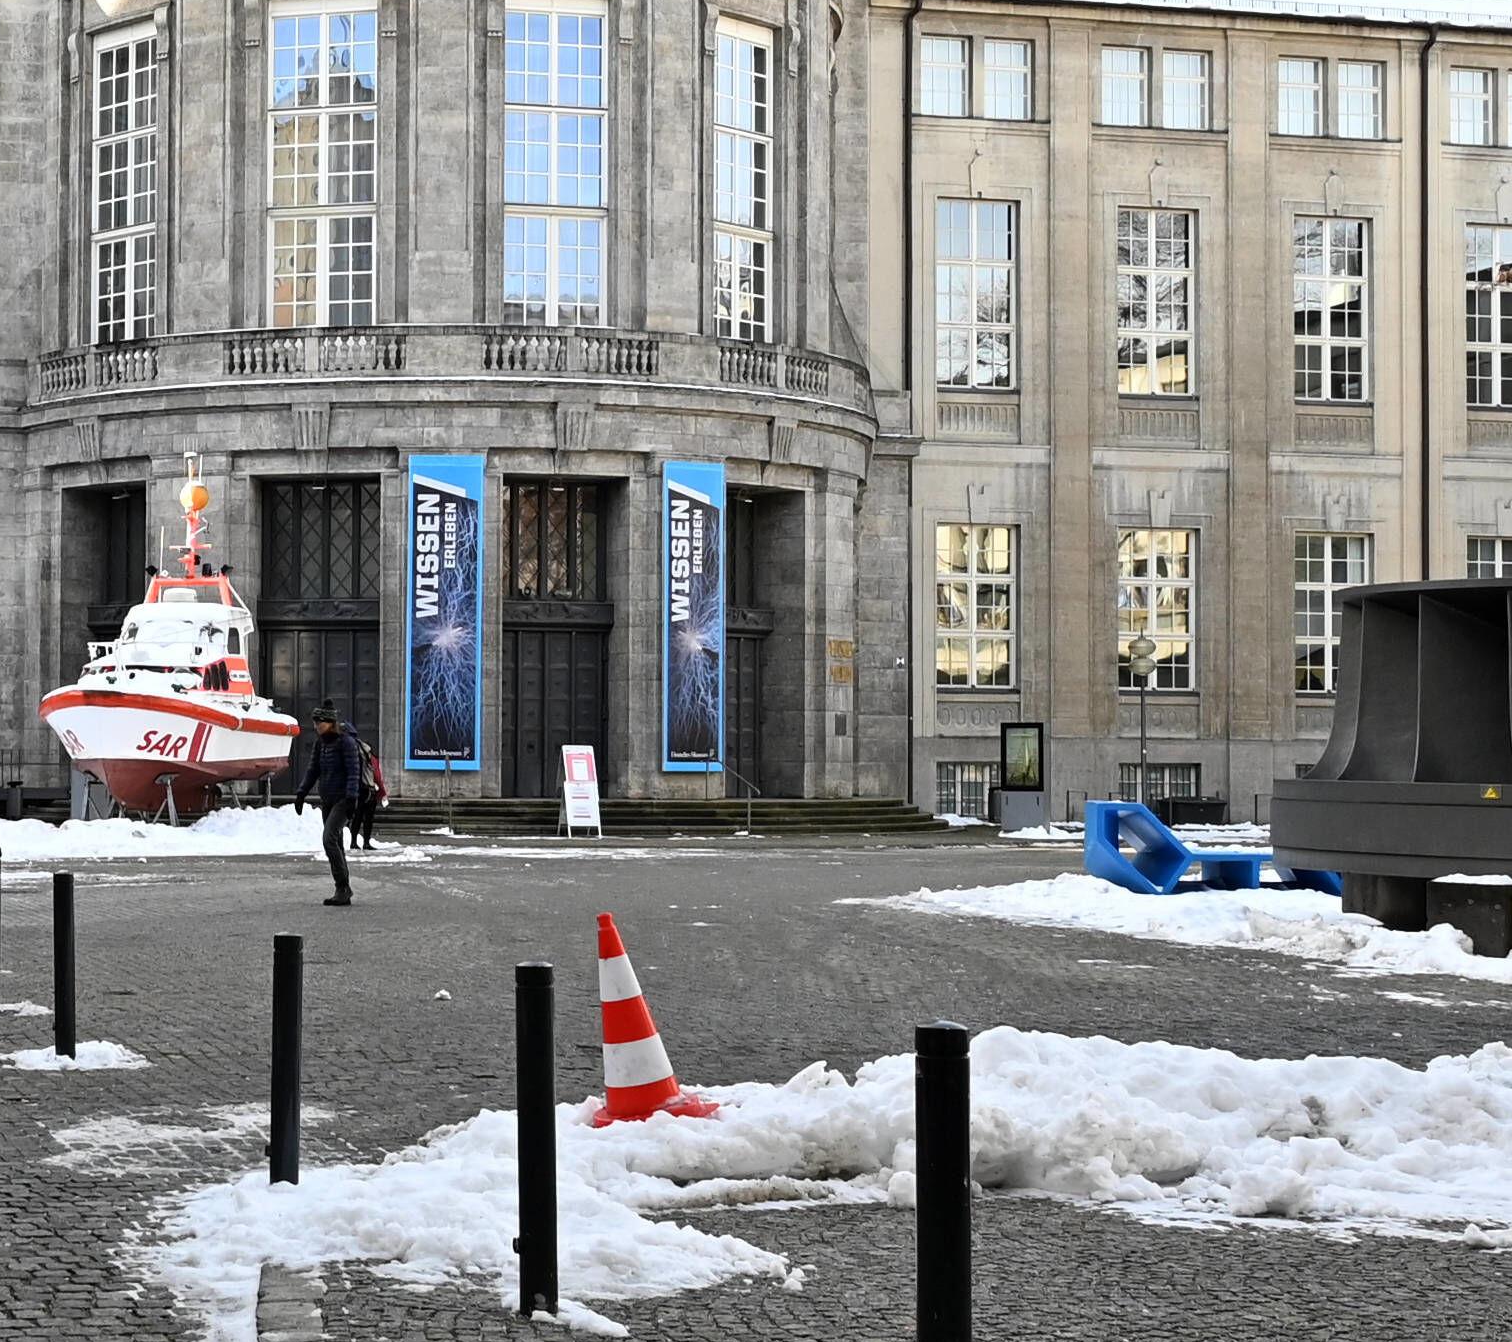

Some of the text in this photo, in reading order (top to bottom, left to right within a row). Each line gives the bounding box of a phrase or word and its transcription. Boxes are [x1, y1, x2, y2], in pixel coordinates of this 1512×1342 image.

[416, 493, 440, 618] WISSEN
[444, 502, 457, 569] ERLEBEN
[671, 499, 690, 623] WISSEN
[692, 509, 703, 574] ERLEBEN
[136, 730, 188, 758] SAR
